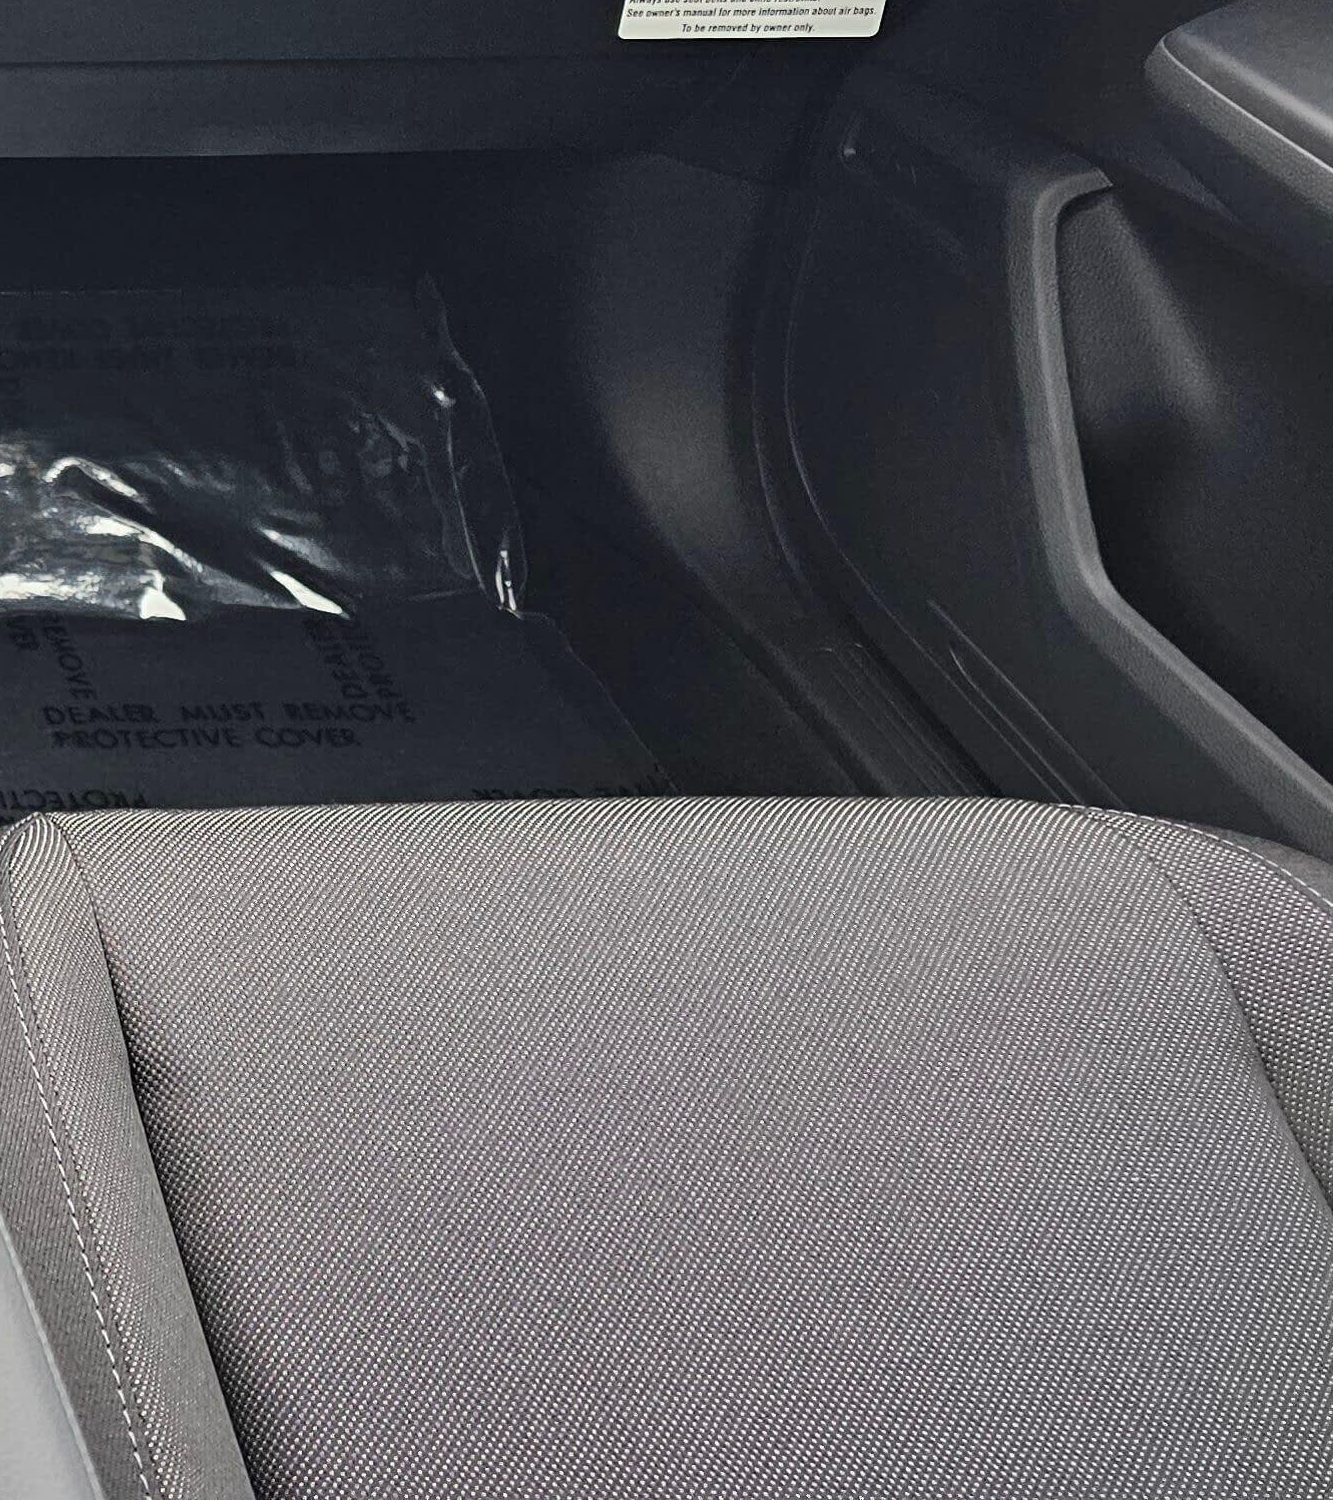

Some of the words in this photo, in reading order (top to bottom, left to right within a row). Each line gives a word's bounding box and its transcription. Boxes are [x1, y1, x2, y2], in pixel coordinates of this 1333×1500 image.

[626, 9, 643, 17] See
[645, 8, 680, 17] owner's
[683, 7, 717, 16] manual
[718, 7, 731, 16] for
[758, 7, 809, 16] information
[811, 7, 837, 15] about
[838, 7, 851, 15] air
[853, 6, 876, 16] bags.
[682, 23, 692, 32] To
[694, 23, 705, 32] be
[707, 23, 748, 32] removed
[750, 23, 761, 33] by
[763, 24, 792, 32] owner
[794, 23, 815, 33] only.
[43, 701, 157, 727] DEALER
[181, 701, 266, 724] MUST
[285, 699, 416, 725] REMOVE
[53, 728, 244, 750] PROTECTIVE
[255, 727, 362, 749] COVER
